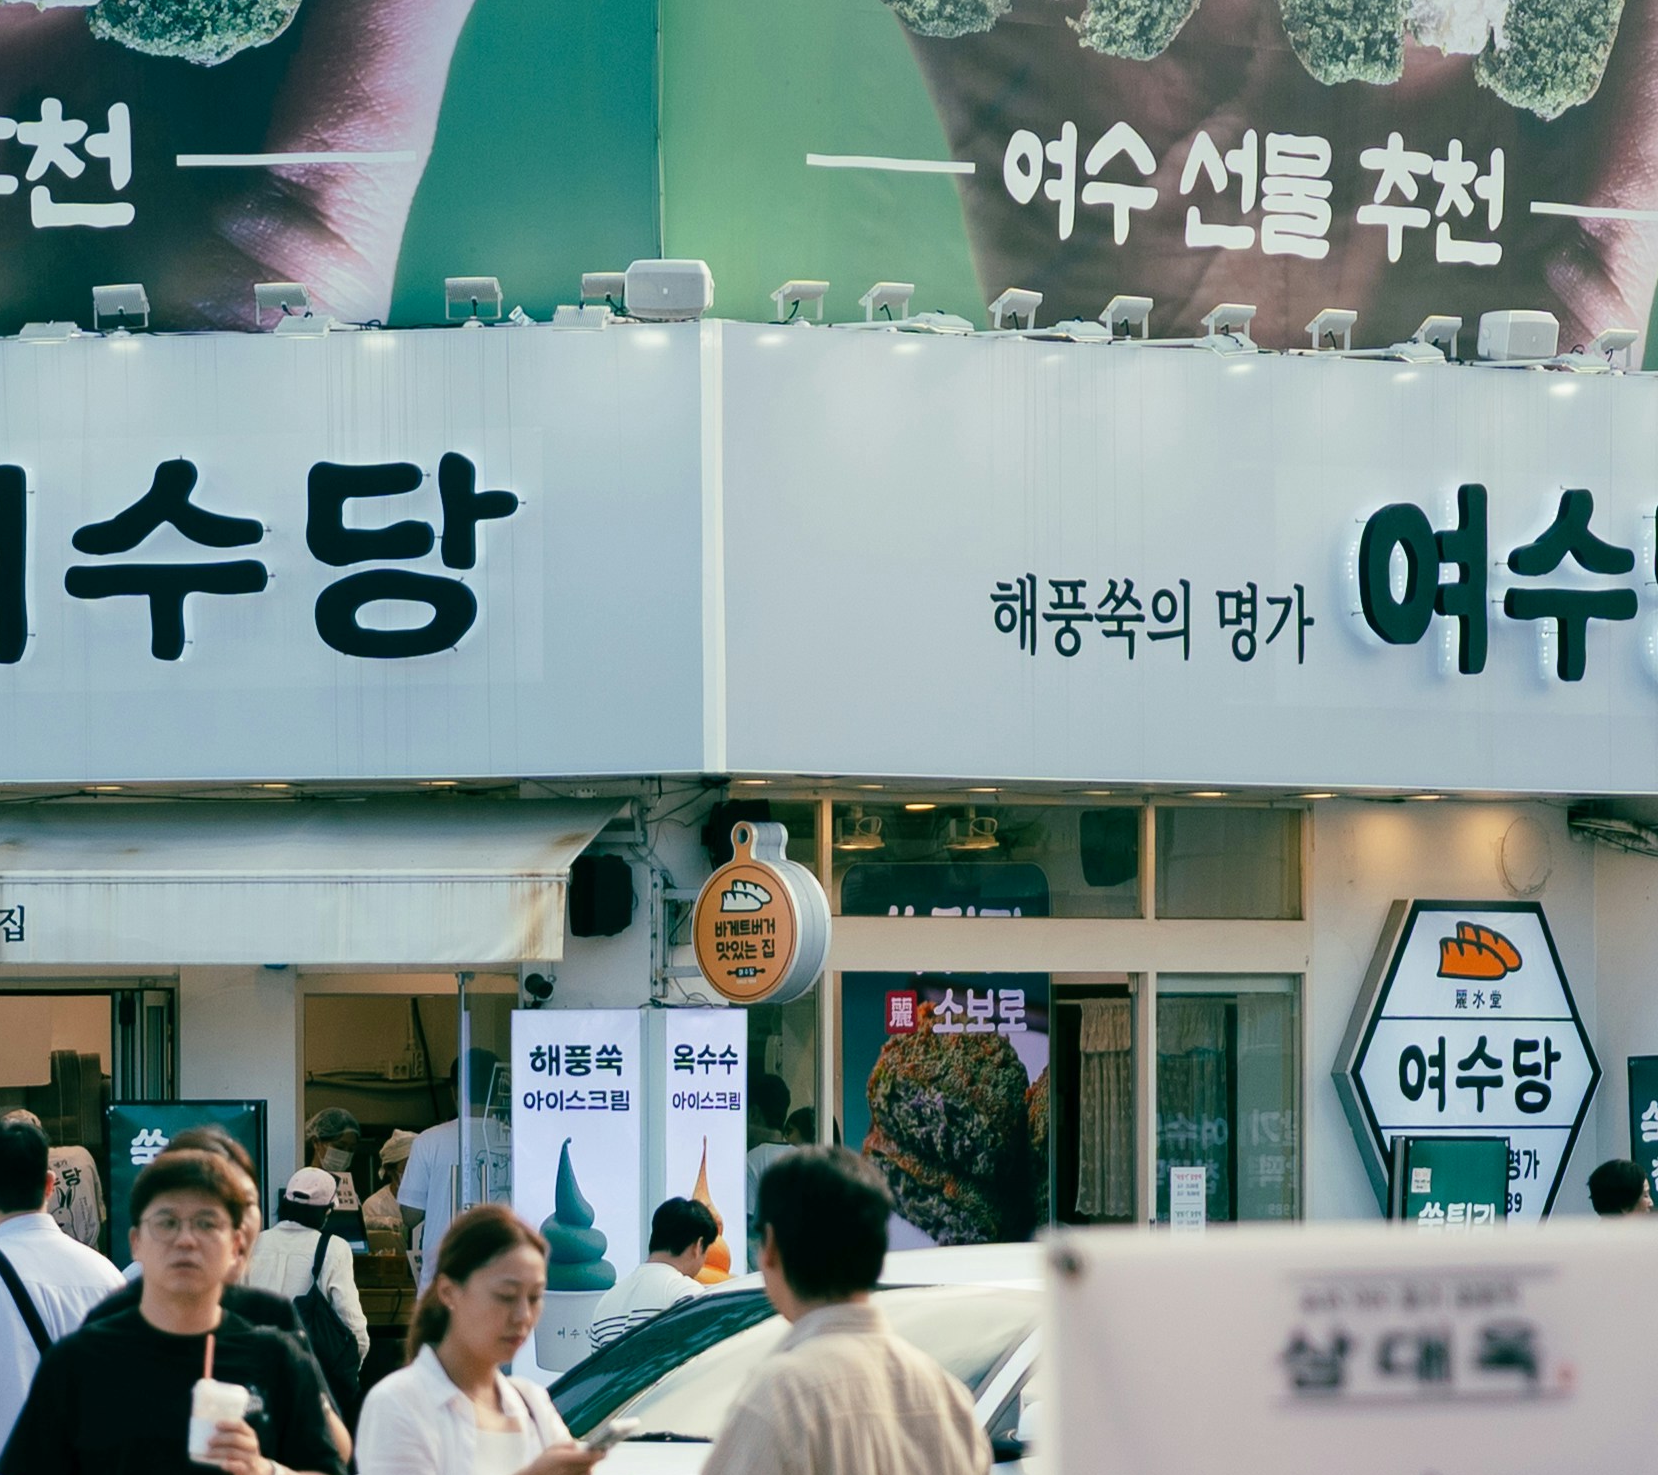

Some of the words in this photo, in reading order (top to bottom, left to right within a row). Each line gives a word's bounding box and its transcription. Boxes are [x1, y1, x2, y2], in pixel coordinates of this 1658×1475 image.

[1001, 120, 1160, 246] 여수
[1180, 127, 1334, 260] 선물
[1357, 131, 1505, 268] 추천
[989, 574, 1193, 663] 해풍쑥의
[1216, 579, 1315, 666] 명가
[714, 917, 776, 938] 바게트버거
[716, 940, 758, 960] 맛있는
[762, 938, 775, 958] 집
[932, 987, 1028, 1034] 소보로
[1454, 988, 1503, 1010] 麗水堂
[529, 1044, 623, 1077] 해풍쑥
[673, 1043, 739, 1075] 옥수수
[1398, 1035, 1562, 1114] 여수당
[523, 1089, 631, 1112] 아이스크림
[672, 1090, 742, 1112] 아이스크림
